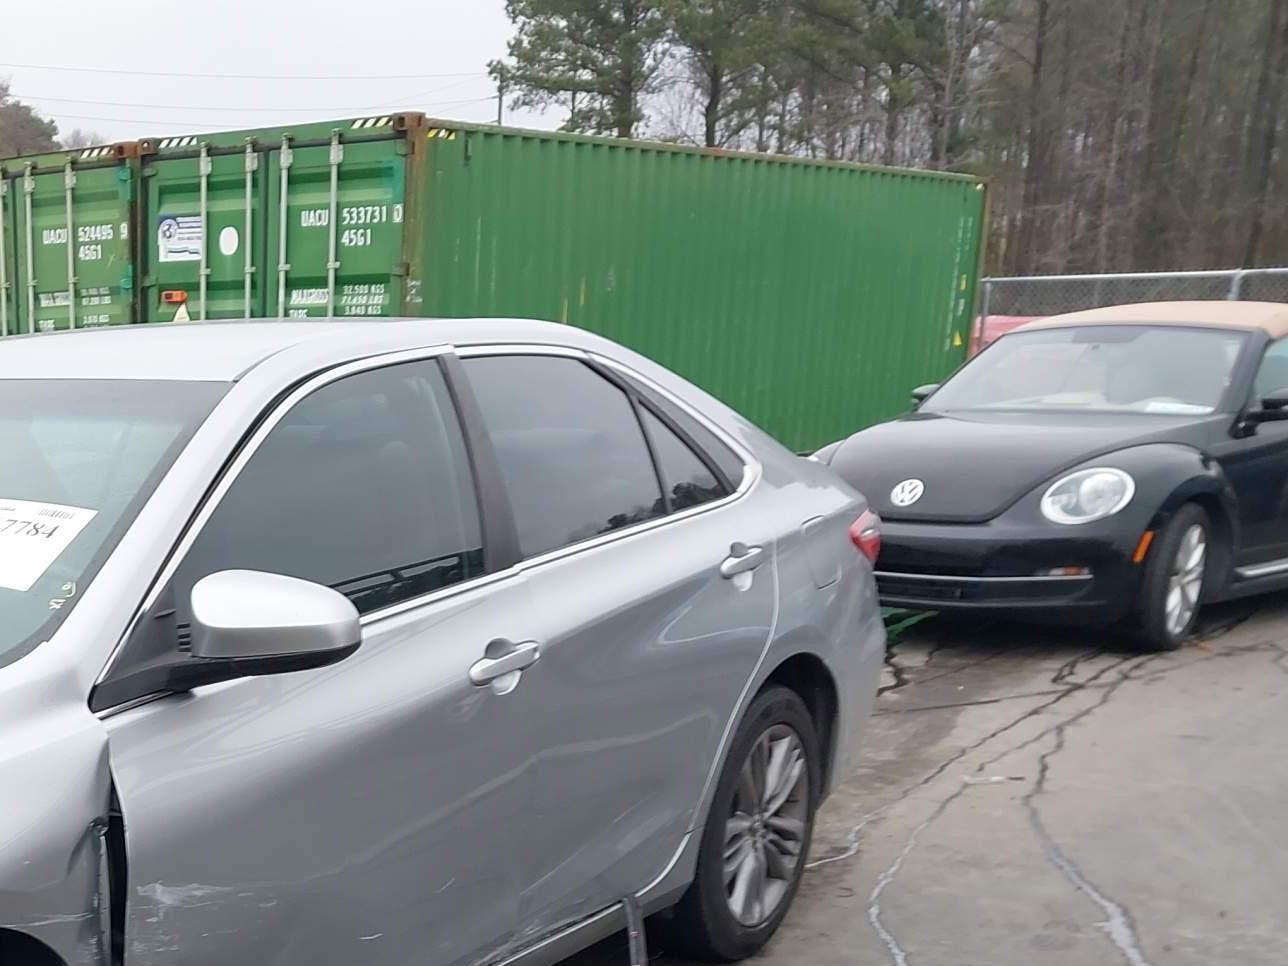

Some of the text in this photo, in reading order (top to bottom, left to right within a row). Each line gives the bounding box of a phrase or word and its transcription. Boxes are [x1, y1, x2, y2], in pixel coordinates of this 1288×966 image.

[300, 208, 329, 227] UACU
[342, 205, 387, 225] 533731
[78, 224, 114, 242] 524495
[341, 228, 372, 247] 45G1
